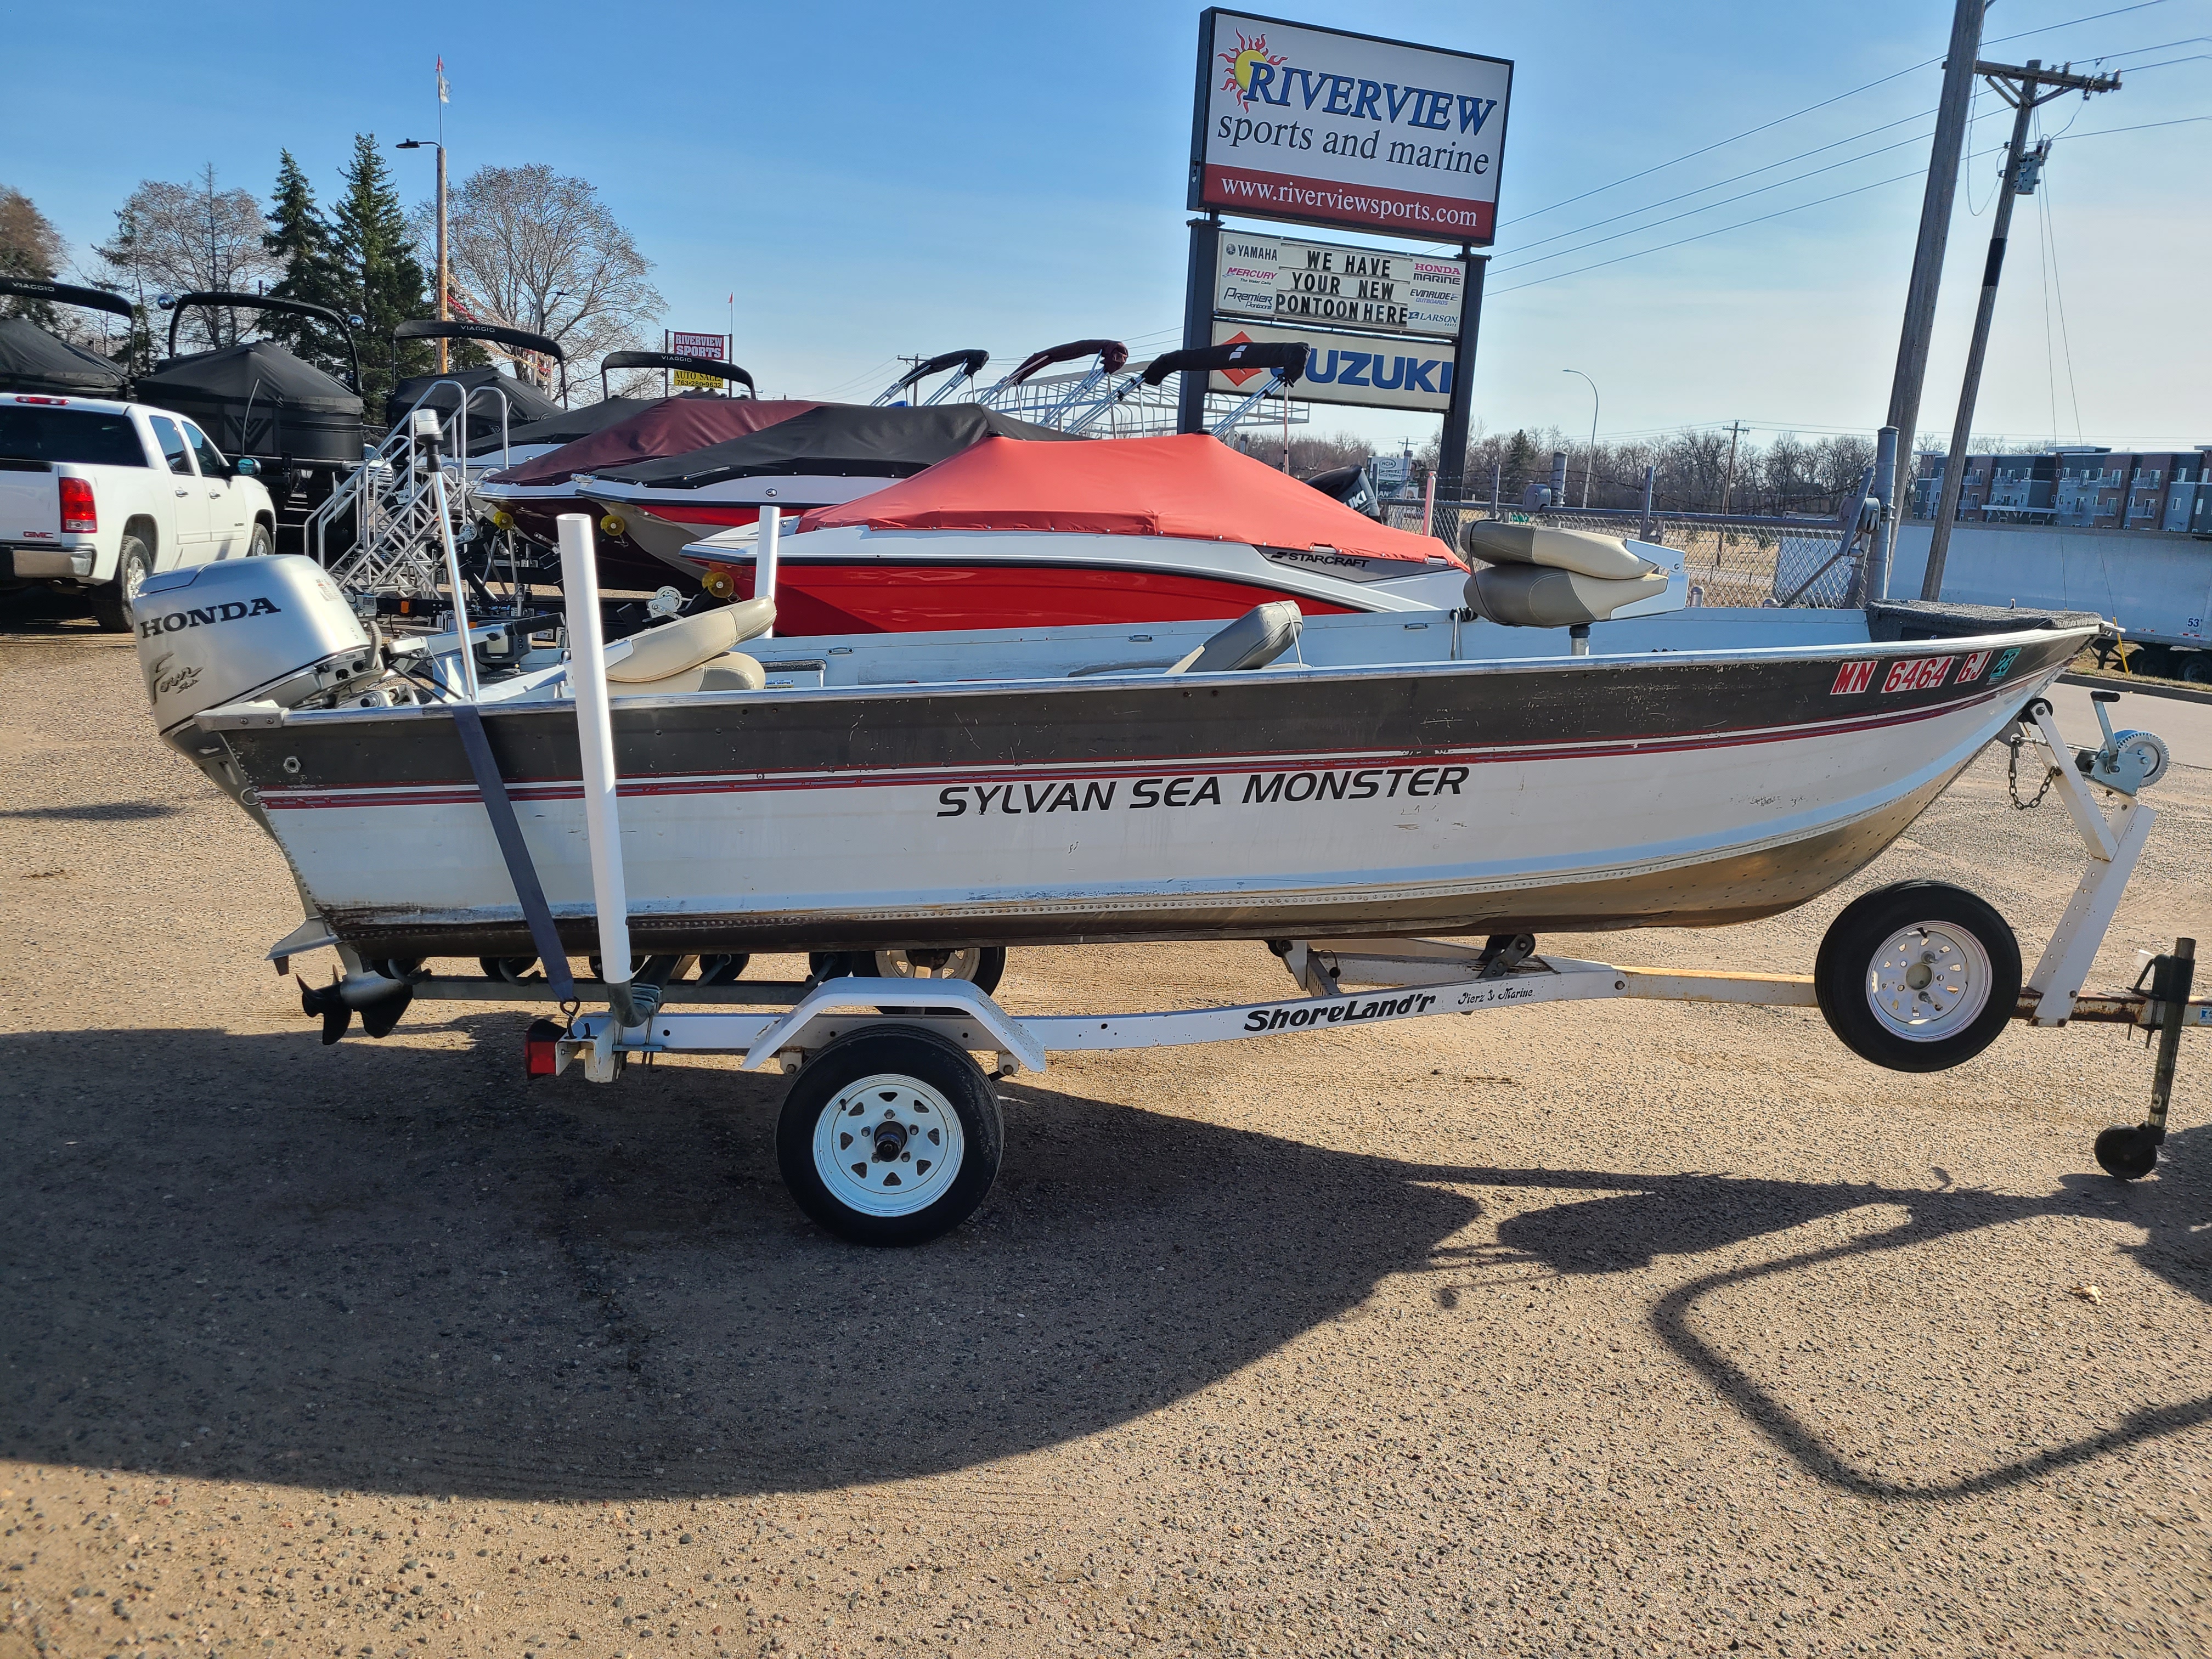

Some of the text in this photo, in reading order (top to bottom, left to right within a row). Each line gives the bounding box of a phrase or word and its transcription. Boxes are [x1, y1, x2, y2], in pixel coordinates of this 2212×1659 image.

[1243, 61, 1497, 136] RIVERVIEW
[1217, 115, 1489, 175] sports and marine
[1221, 177, 1477, 227] www.riverviewsports.com
[1238, 245, 1277, 261] YAMAHA
[1307, 250, 1391, 278] WE HAVE
[1414, 263, 1461, 275] HONDA
[1227, 267, 1278, 280] MERCURY
[1413, 273, 1461, 285] MARINE
[12, 281, 55, 292] VIAGGIO
[1292, 272, 1395, 300] YOUR NEW
[1410, 289, 1451, 301] EVINRUDE
[1245, 301, 1272, 310] Pontoons
[1276, 293, 1408, 325] PONTOON HERE
[1419, 313, 1458, 323] LARSON
[460, 325, 495, 333] VIAGGIO
[675, 334, 723, 347] RIVERVIEW
[676, 345, 721, 358] SPORTS
[674, 370, 696, 380] AUTO
[1270, 347, 1454, 394] UZUKI
[1289, 552, 1370, 567] STARCRAFT
[140, 597, 282, 639] HONDA
[1991, 653, 2016, 674] 23
[1831, 651, 1991, 694] MN 6464 GJ
[936, 766, 1470, 817] SYLVAN SEA MONSTER
[1498, 987, 1533, 1000] Marine
